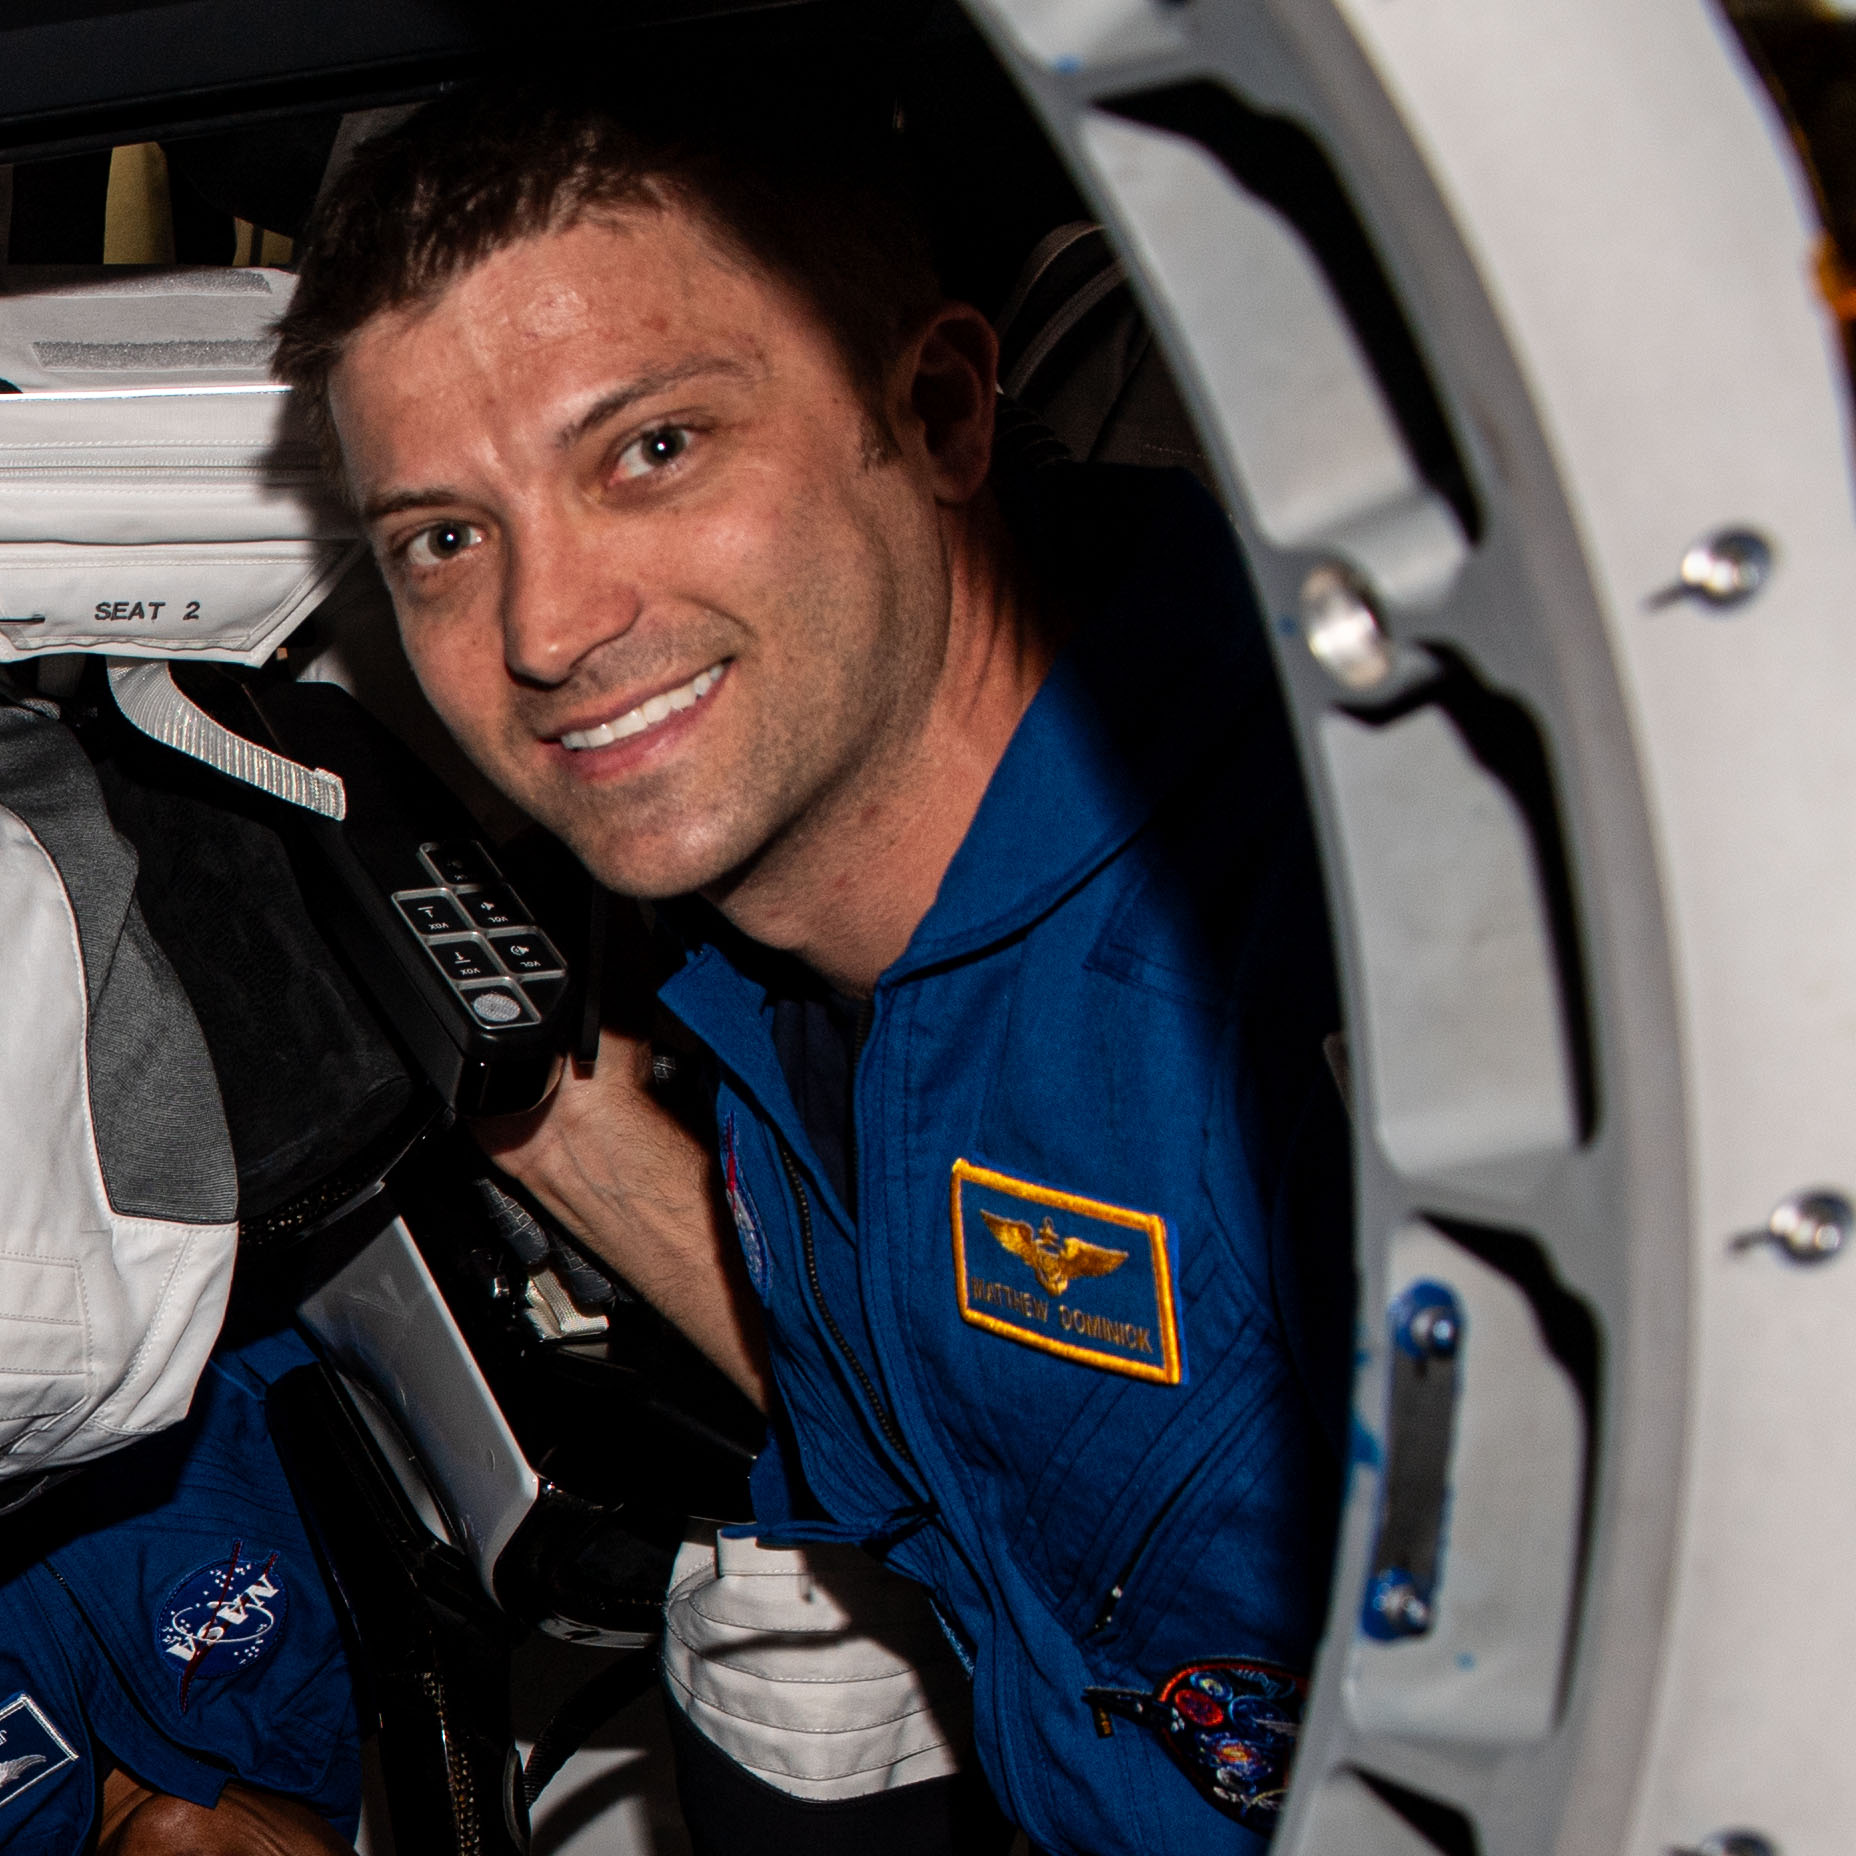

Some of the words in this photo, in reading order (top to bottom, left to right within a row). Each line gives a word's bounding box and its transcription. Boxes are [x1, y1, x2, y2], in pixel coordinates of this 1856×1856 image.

[94, 601, 167, 621] SEAT
[182, 600, 201, 621] 2
[971, 1276, 1049, 1323] MATTHEW
[1058, 1304, 1153, 1354] DOMINICK
[166, 1573, 280, 1661] NASA
